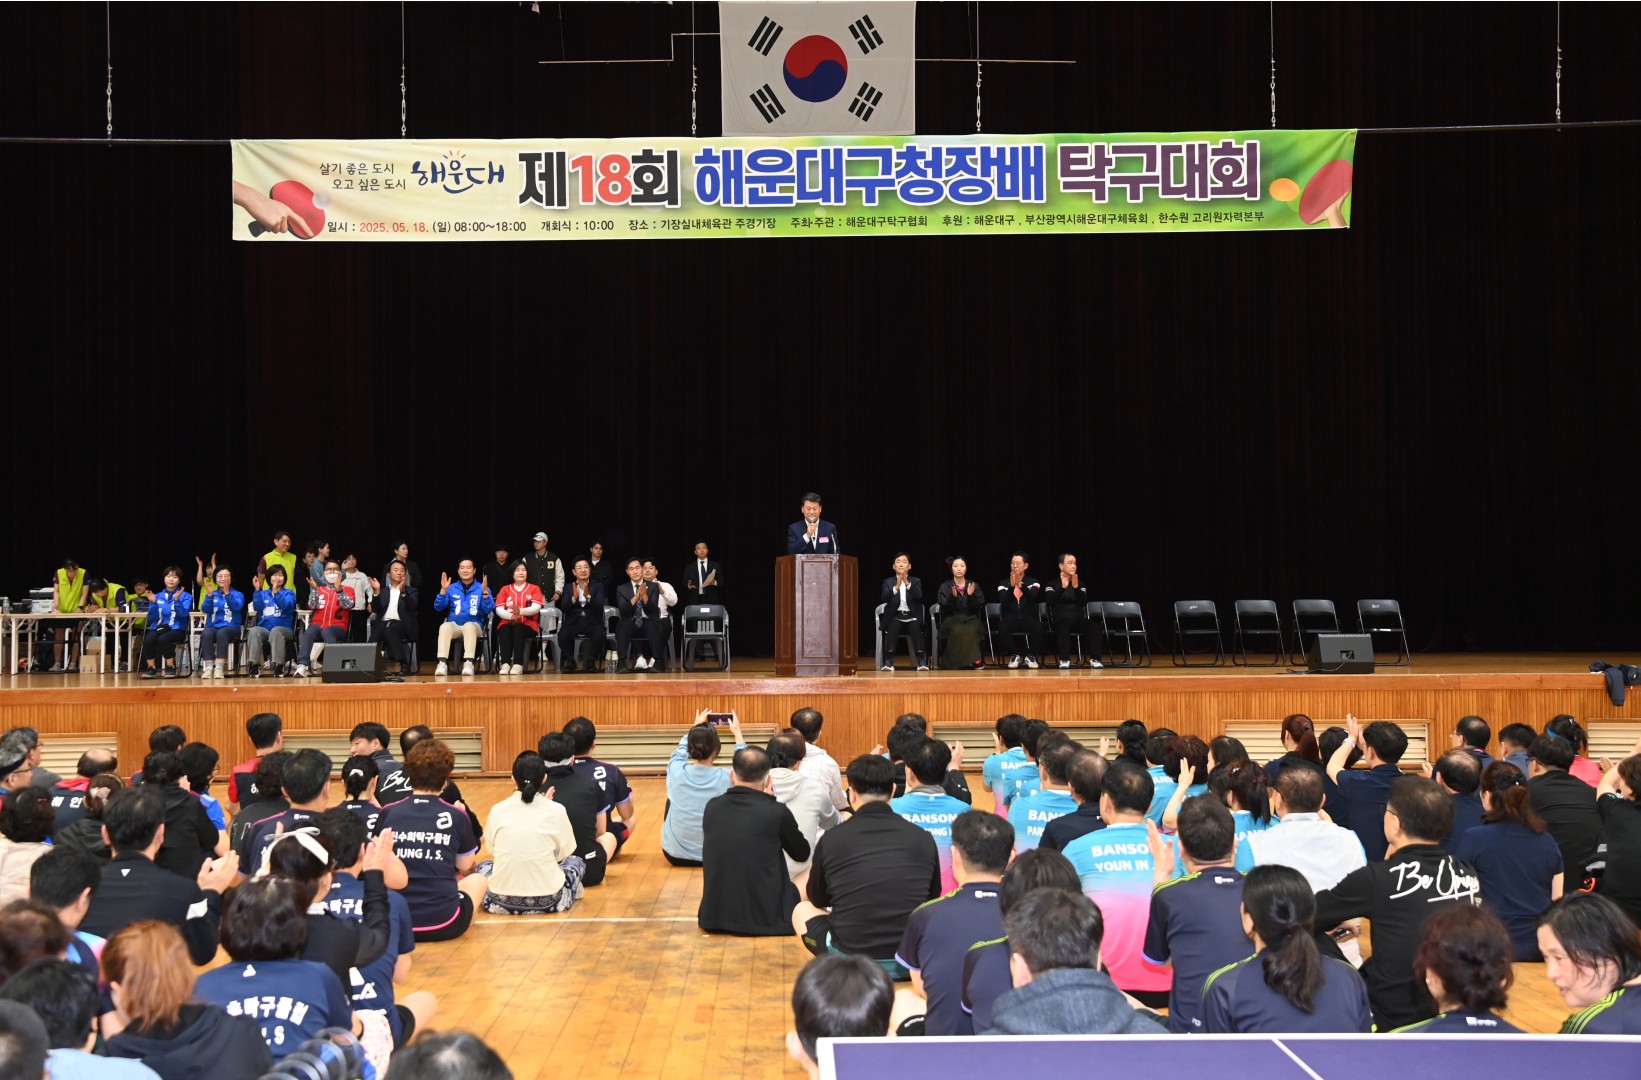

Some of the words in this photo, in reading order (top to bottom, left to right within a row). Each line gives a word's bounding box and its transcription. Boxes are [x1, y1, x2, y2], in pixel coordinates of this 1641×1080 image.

[319, 163, 342, 175] 살기
[345, 163, 369, 175] 좋은
[371, 163, 395, 175] 도시
[410, 159, 505, 194] 해운대
[517, 148, 680, 208] 제18회
[694, 145, 1045, 206] 해운대구청장배
[1058, 140, 1259, 203] 탁구대회
[332, 179, 355, 190] 오고
[358, 179, 381, 191] 싶은
[383, 179, 406, 190] 도시
[327, 221, 348, 233] 일시
[359, 222, 389, 233] 2025.
[392, 222, 409, 233] 05.
[413, 222, 429, 232] 18.
[432, 221, 451, 233] (일)
[454, 221, 527, 232] 08:00~18:00
[541, 220, 572, 231] 개회식
[583, 220, 614, 231] 10:00
[628, 219, 649, 231] 장소
[660, 218, 732, 230] 기장실내체육관
[735, 217, 777, 229] 주경기장
[846, 215, 928, 228] 해운대구탁구협회
[942, 215, 963, 227] 후원
[974, 214, 1015, 226] 해운대구
[1025, 213, 1148, 226] 부산광역시해운대구체육회
[1158, 212, 1189, 224] 한수원
[1192, 211, 1265, 223] 고리원자력본부
